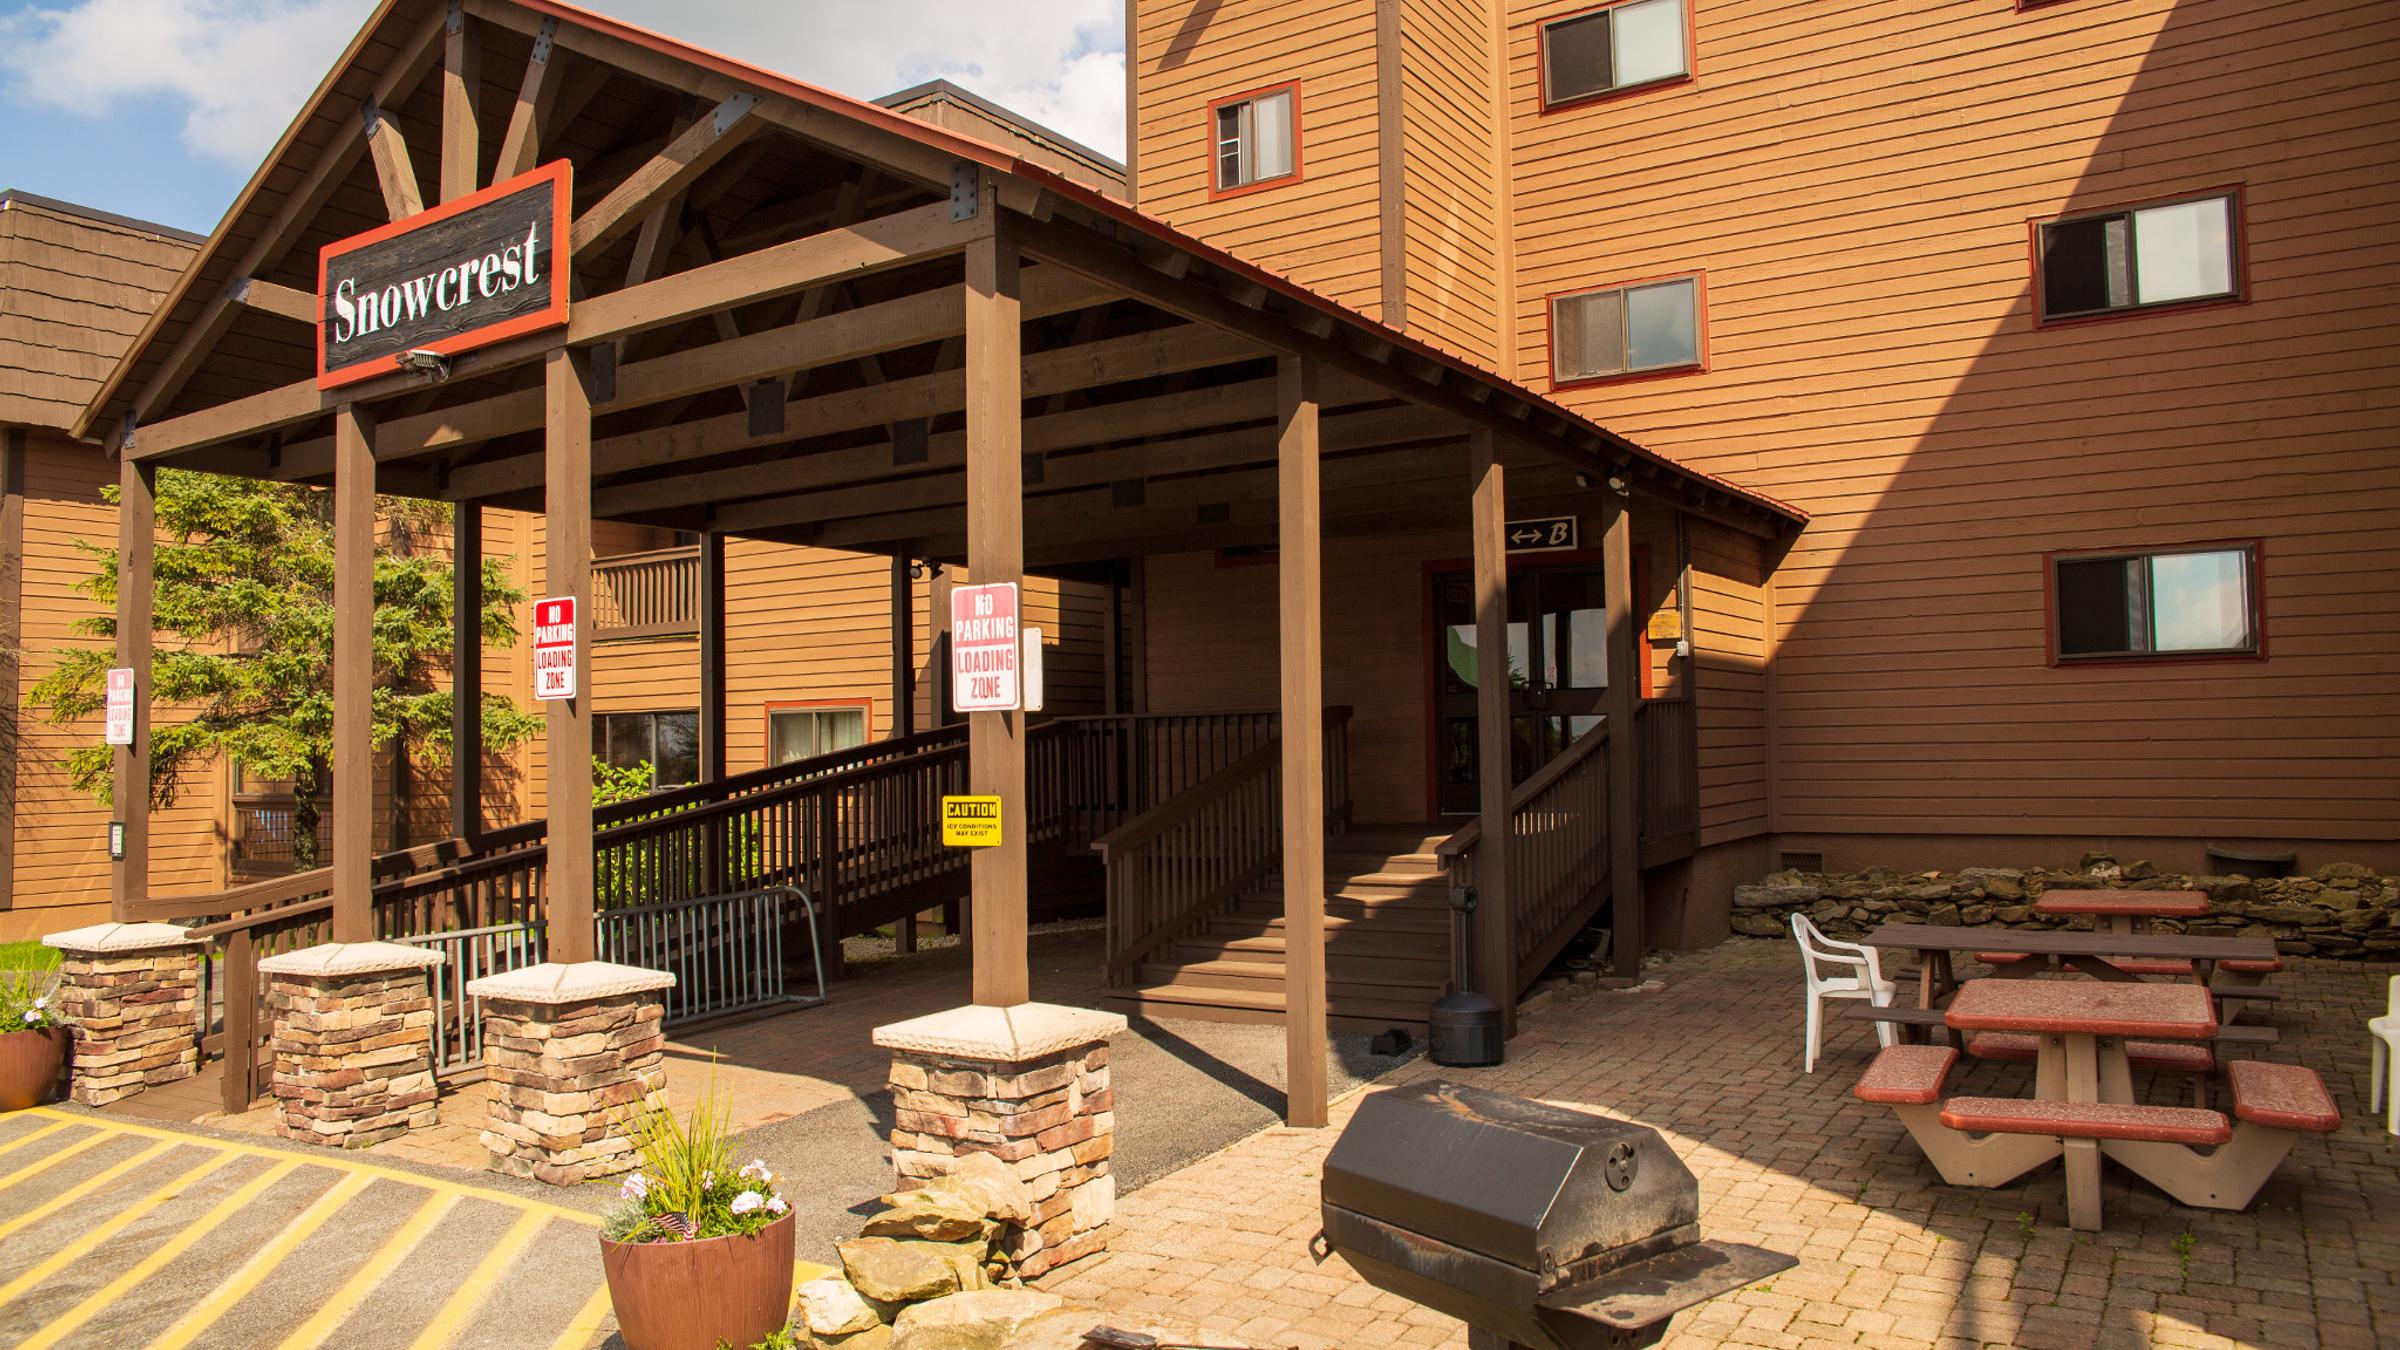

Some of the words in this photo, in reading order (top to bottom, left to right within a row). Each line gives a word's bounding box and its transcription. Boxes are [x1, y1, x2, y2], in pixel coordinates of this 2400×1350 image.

[335, 221, 540, 344] Snowcrest
[1548, 522, 1568, 545] B
[548, 605, 561, 624] NO
[975, 594, 993, 616] NO
[536, 623, 573, 644] PARKING
[955, 616, 1014, 641] PARKING
[537, 649, 572, 669] LOADING
[957, 648, 1014, 674] LOADING
[546, 671, 565, 690] ZONE
[971, 676, 1001, 699] ZONE
[948, 803, 996, 817] CAUTION
